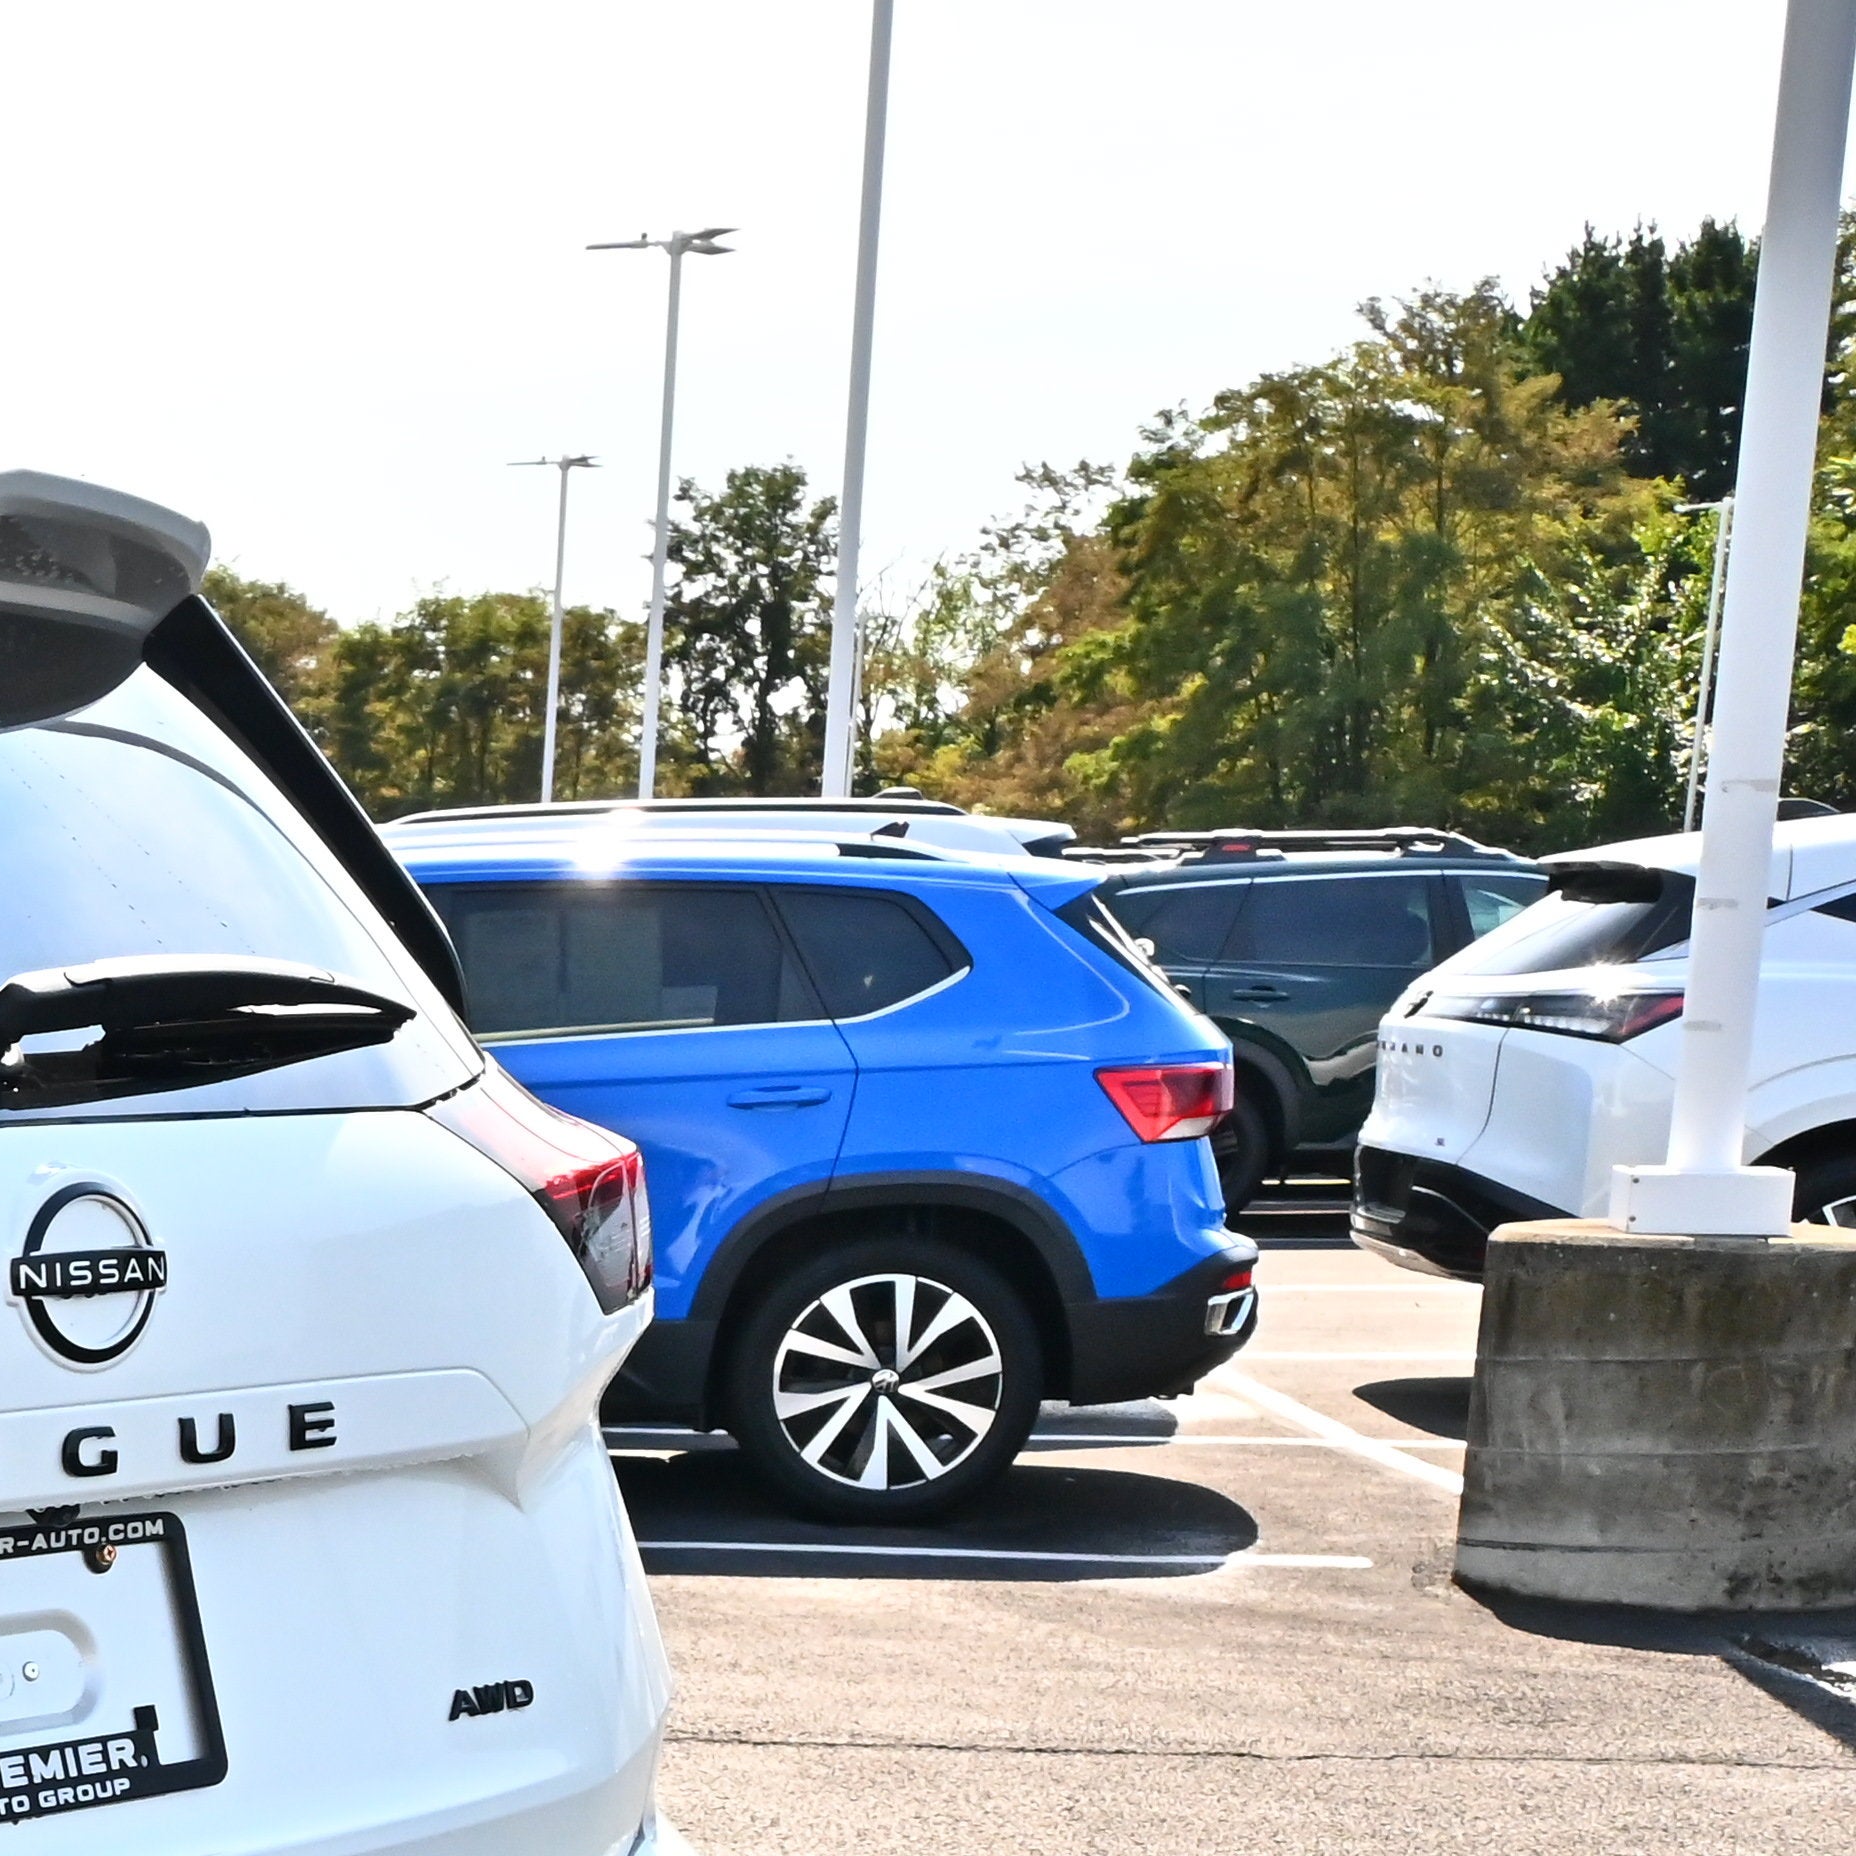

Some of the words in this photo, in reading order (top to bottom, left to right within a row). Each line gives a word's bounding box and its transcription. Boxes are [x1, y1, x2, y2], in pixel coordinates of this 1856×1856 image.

[19, 1257, 167, 1291] NISSAN
[448, 1679, 535, 1722] AWD
[38, 1776, 132, 1808] GROUP
